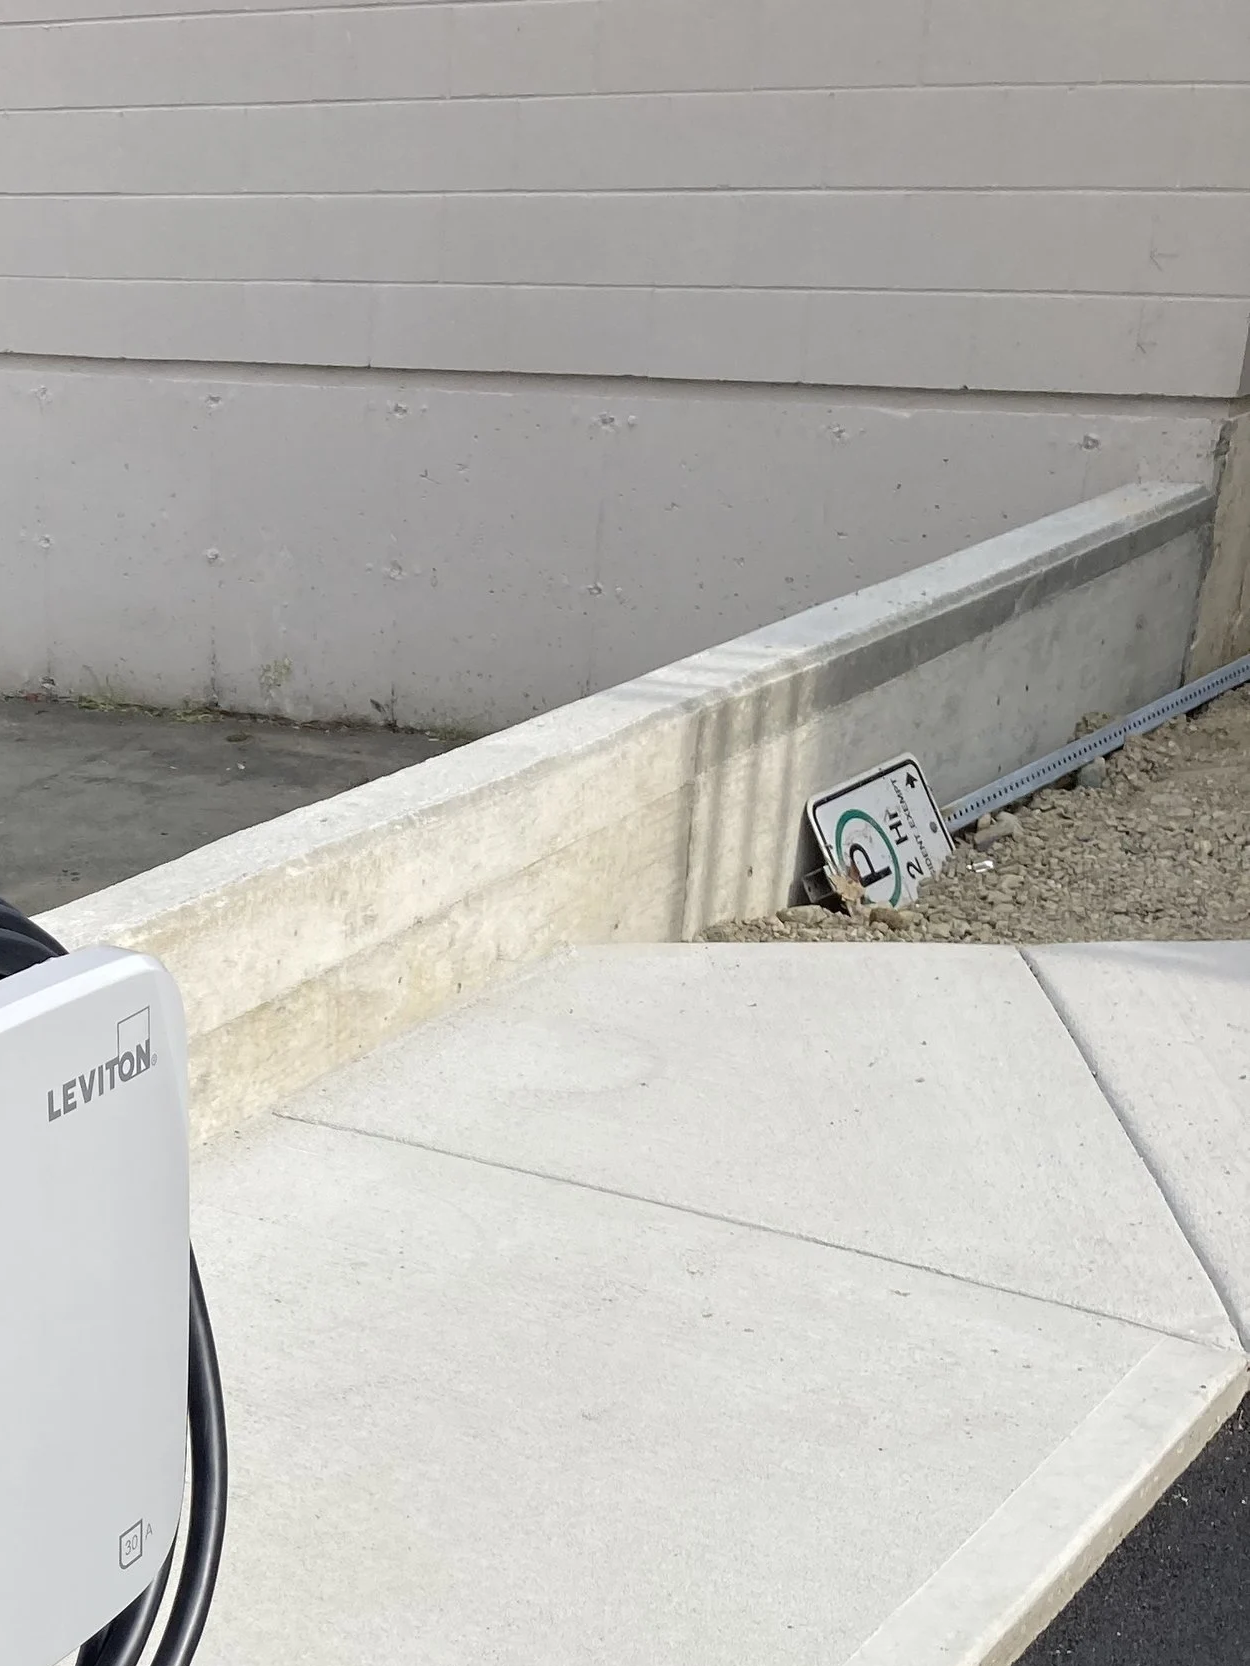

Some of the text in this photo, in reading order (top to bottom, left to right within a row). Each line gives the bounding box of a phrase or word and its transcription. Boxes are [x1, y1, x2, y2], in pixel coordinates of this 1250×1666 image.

[890, 779, 915, 828] EXEMPT
[850, 843, 892, 888] P
[906, 857, 924, 879] 2
[124, 1523, 153, 1556] 30 A
